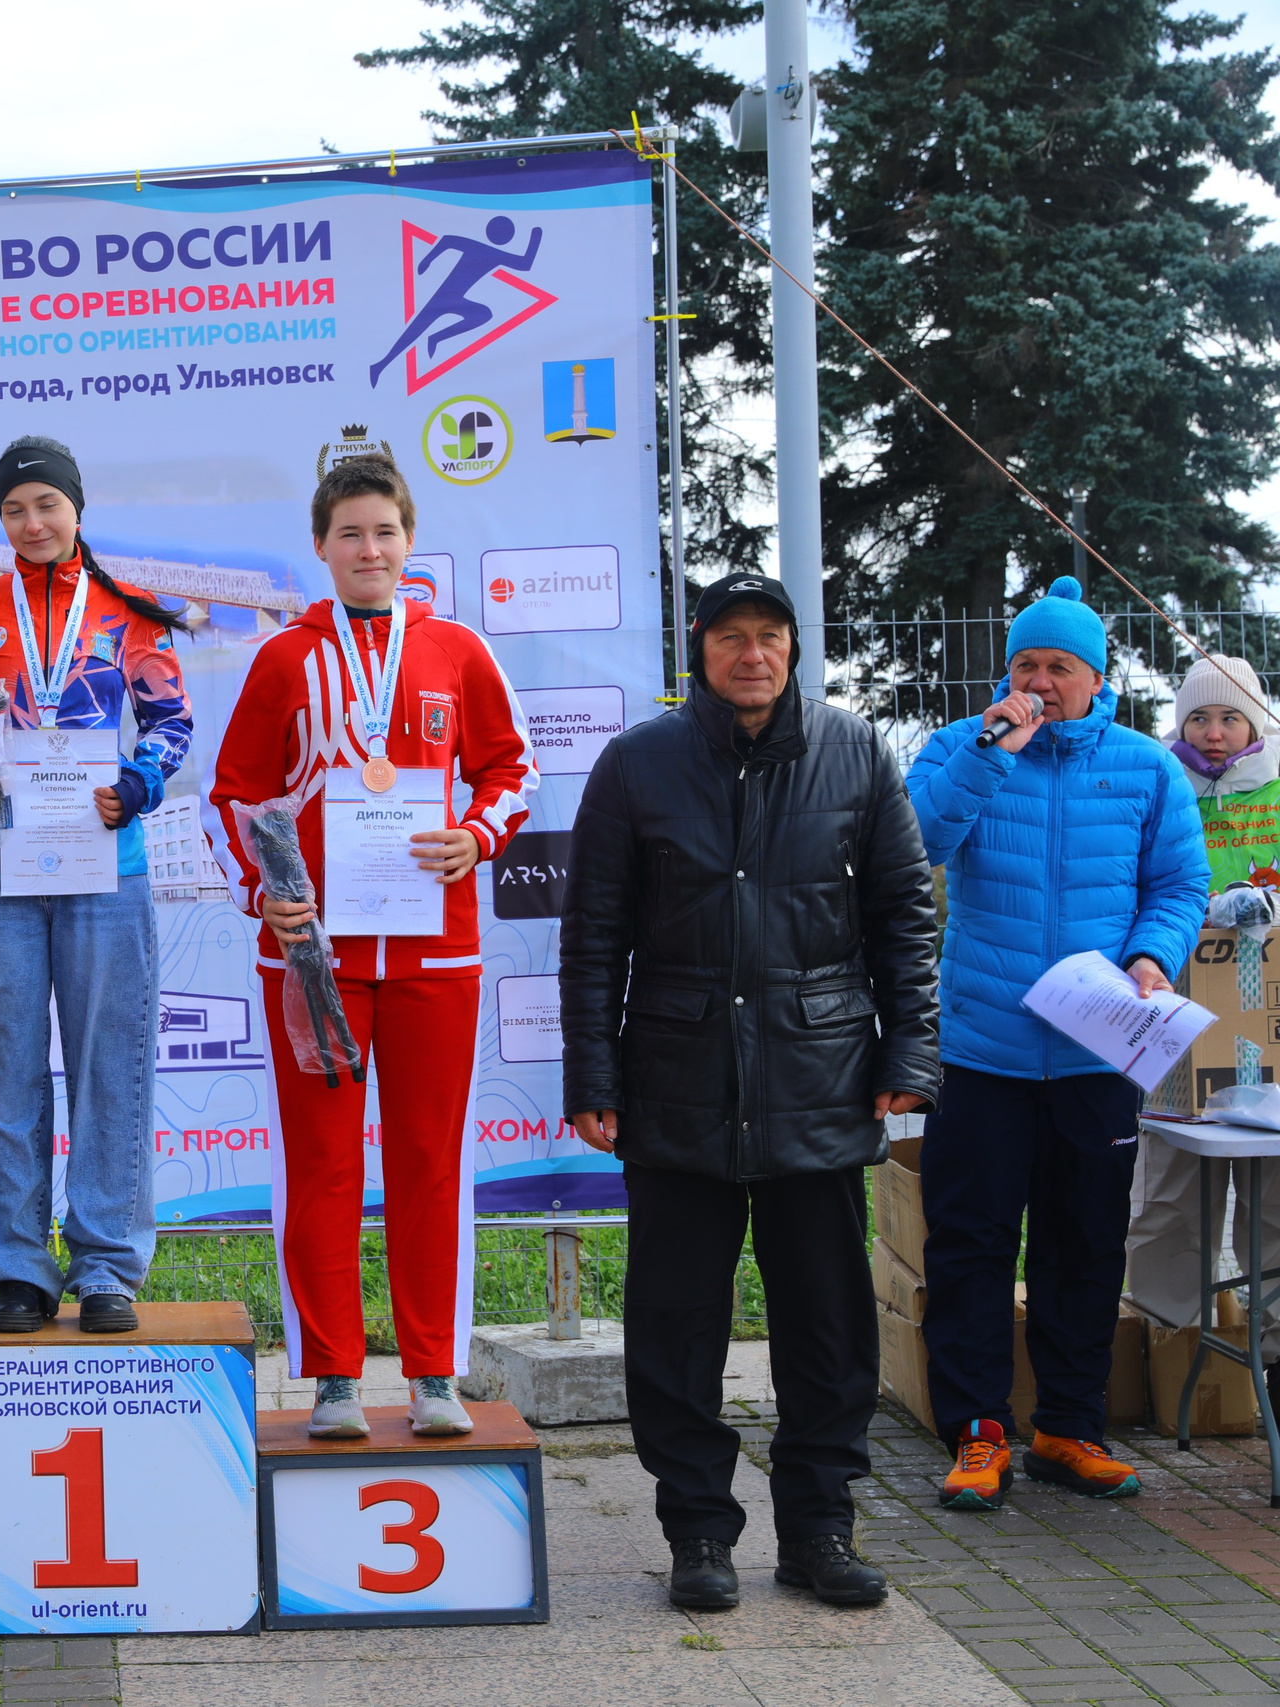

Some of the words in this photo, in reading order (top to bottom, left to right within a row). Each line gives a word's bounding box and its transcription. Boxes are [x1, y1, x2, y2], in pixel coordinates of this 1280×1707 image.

[95, 220, 332, 275] РОССИИ
[29, 278, 335, 321] СОРЕВНОВАНИЯ
[79, 317, 336, 353] ОРИЕНТИРОВАНИЯ
[82, 371, 171, 401] город
[177, 362, 335, 391] Ульяновск
[333, 443, 377, 453] ТРИУМФ
[441, 460, 495, 472] УЛСПОРТ
[522, 571, 613, 594] azimut
[528, 713, 592, 724] МЕТАЛЛО
[529, 723, 622, 736] ПРОФИЛЬНЫЙ
[529, 738, 574, 748] ЗАВОД
[30, 772, 87, 783] ДИПЛОМ
[355, 810, 413, 821] ДИПЛОМ
[1127, 1006, 1162, 1048] ДИПЛОМ
[74, 1358, 215, 1375] СПОРТИВНОГО
[113, 1399, 202, 1416] ОБЛАСТИ
[31, 1427, 139, 1589] 1
[357, 1478, 446, 1595] 3
[31, 1600, 148, 1619] ul-orient.ru
